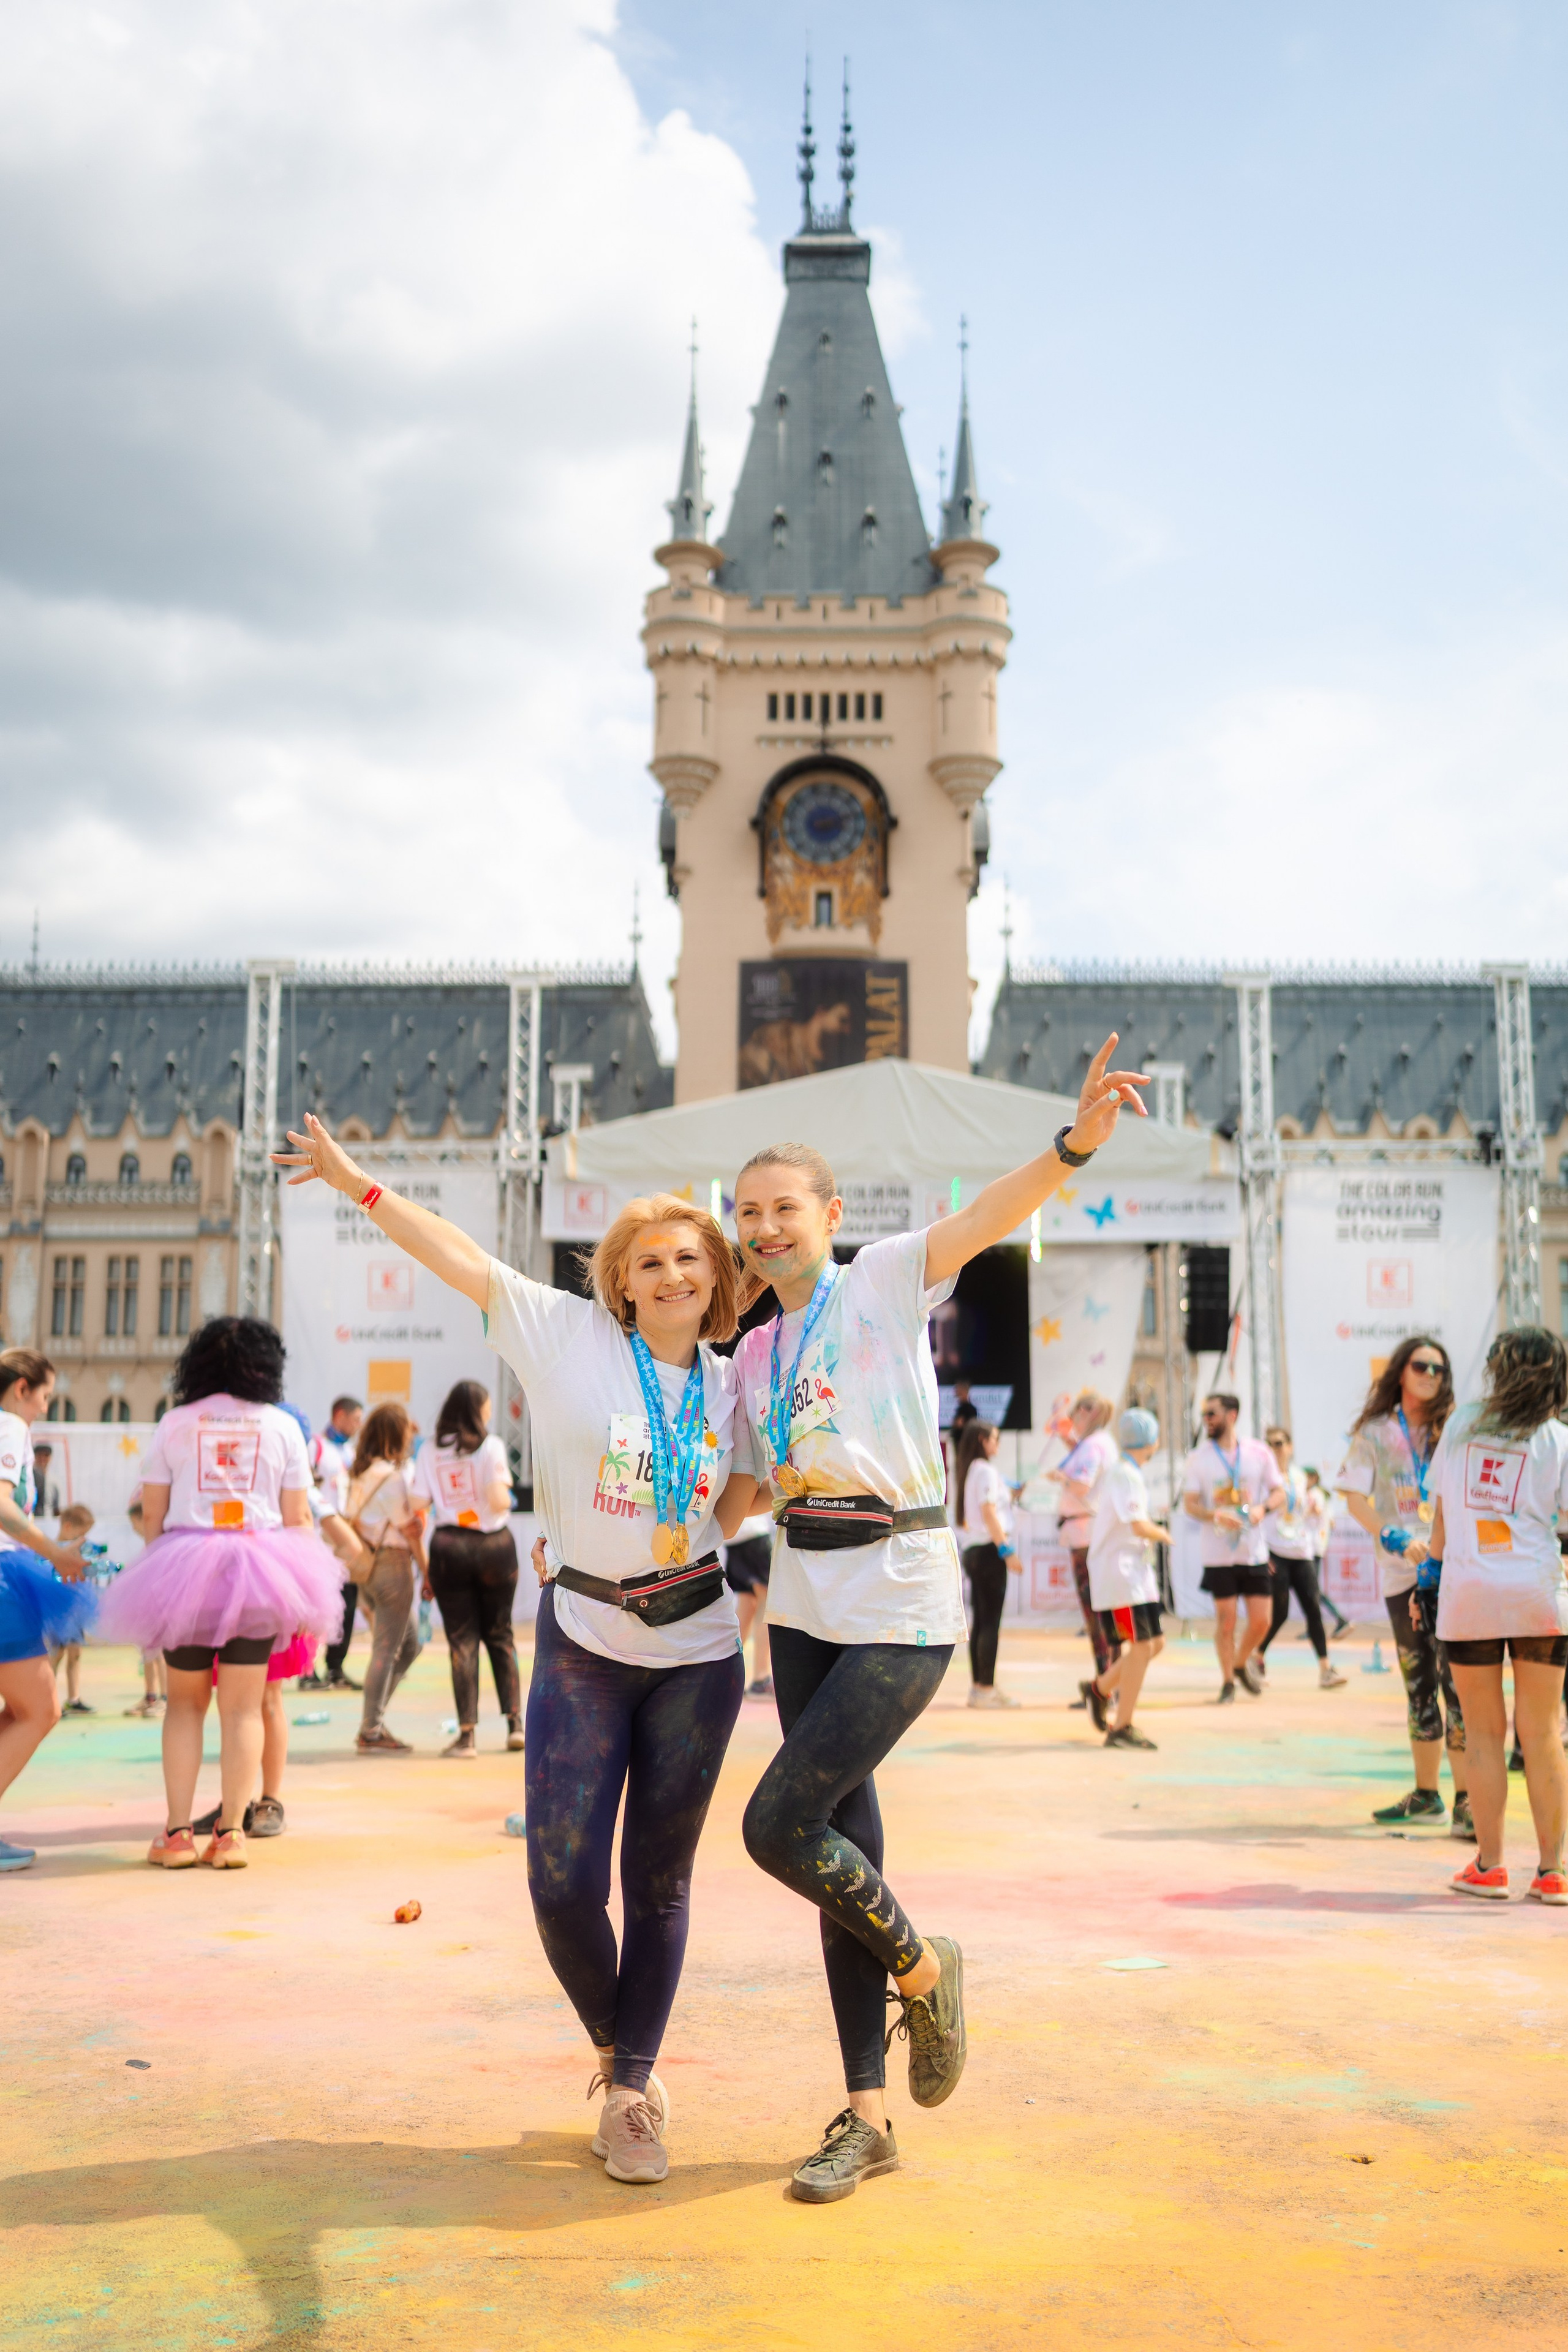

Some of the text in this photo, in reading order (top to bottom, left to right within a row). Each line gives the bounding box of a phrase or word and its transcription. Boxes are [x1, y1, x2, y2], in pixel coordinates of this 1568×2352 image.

[1366, 1180, 1412, 1199] COLOR
[1415, 1180, 1443, 1199] RUN
[1336, 1202, 1442, 1227] amazing
[1352, 1223, 1398, 1243] tour
[683, 1409, 692, 1423] COLOR
[1479, 1458, 1506, 1488] K
[813, 1499, 840, 1508] UniCredit
[665, 1566, 686, 1577] UniCredit
